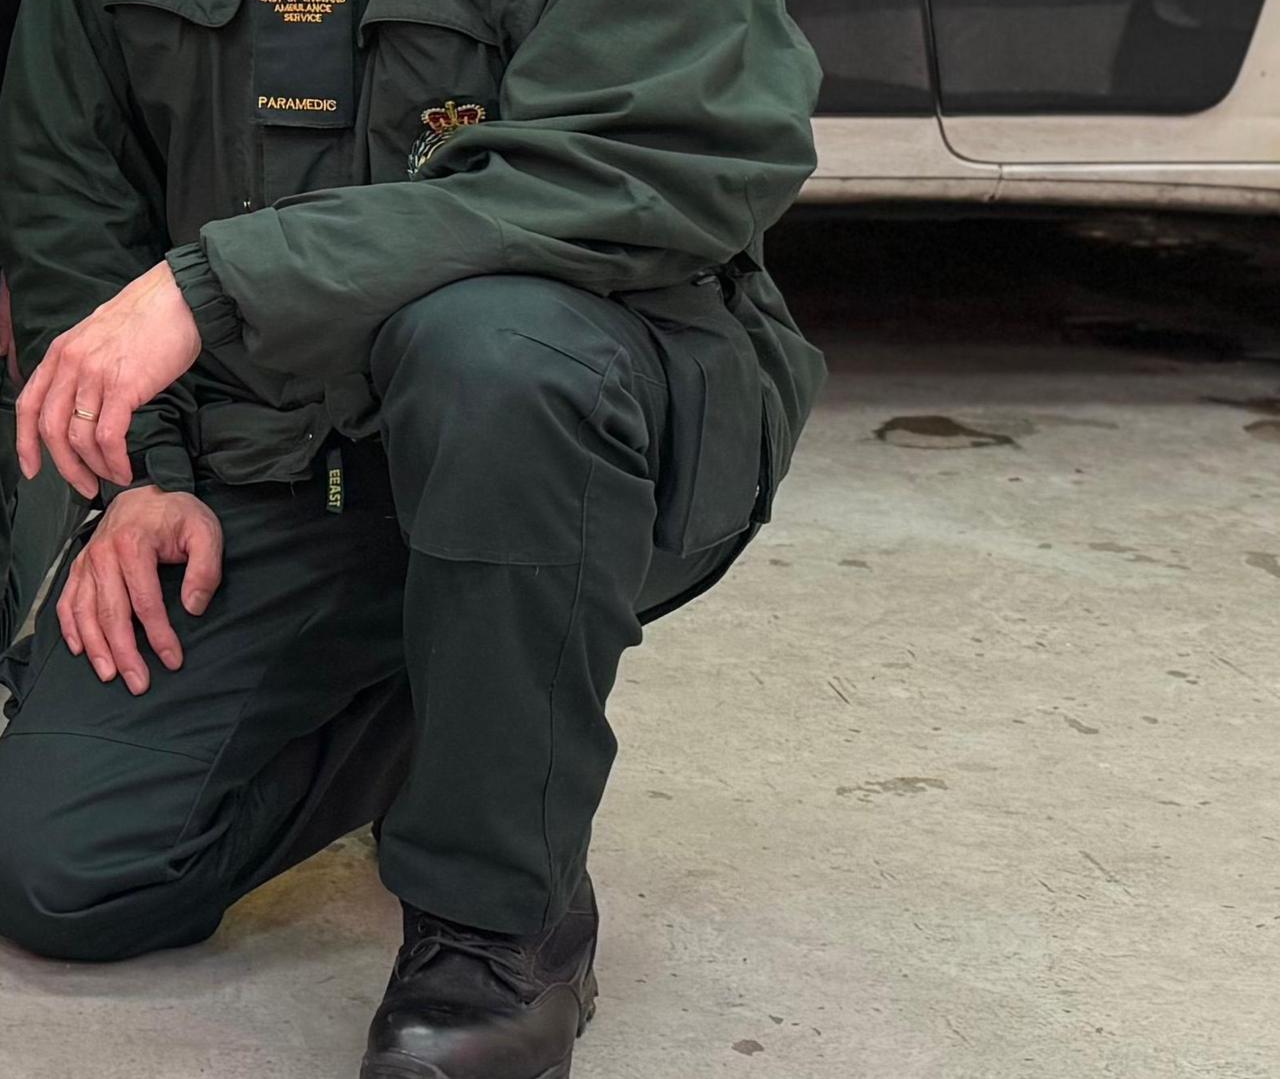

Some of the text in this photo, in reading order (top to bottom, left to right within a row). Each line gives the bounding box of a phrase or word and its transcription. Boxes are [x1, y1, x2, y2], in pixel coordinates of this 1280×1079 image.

[274, 3, 332, 13] AMBULANCE
[283, 12, 322, 23] SERVICE
[258, 96, 337, 111] PARAMEDIC
[328, 469, 341, 507] EEAST
